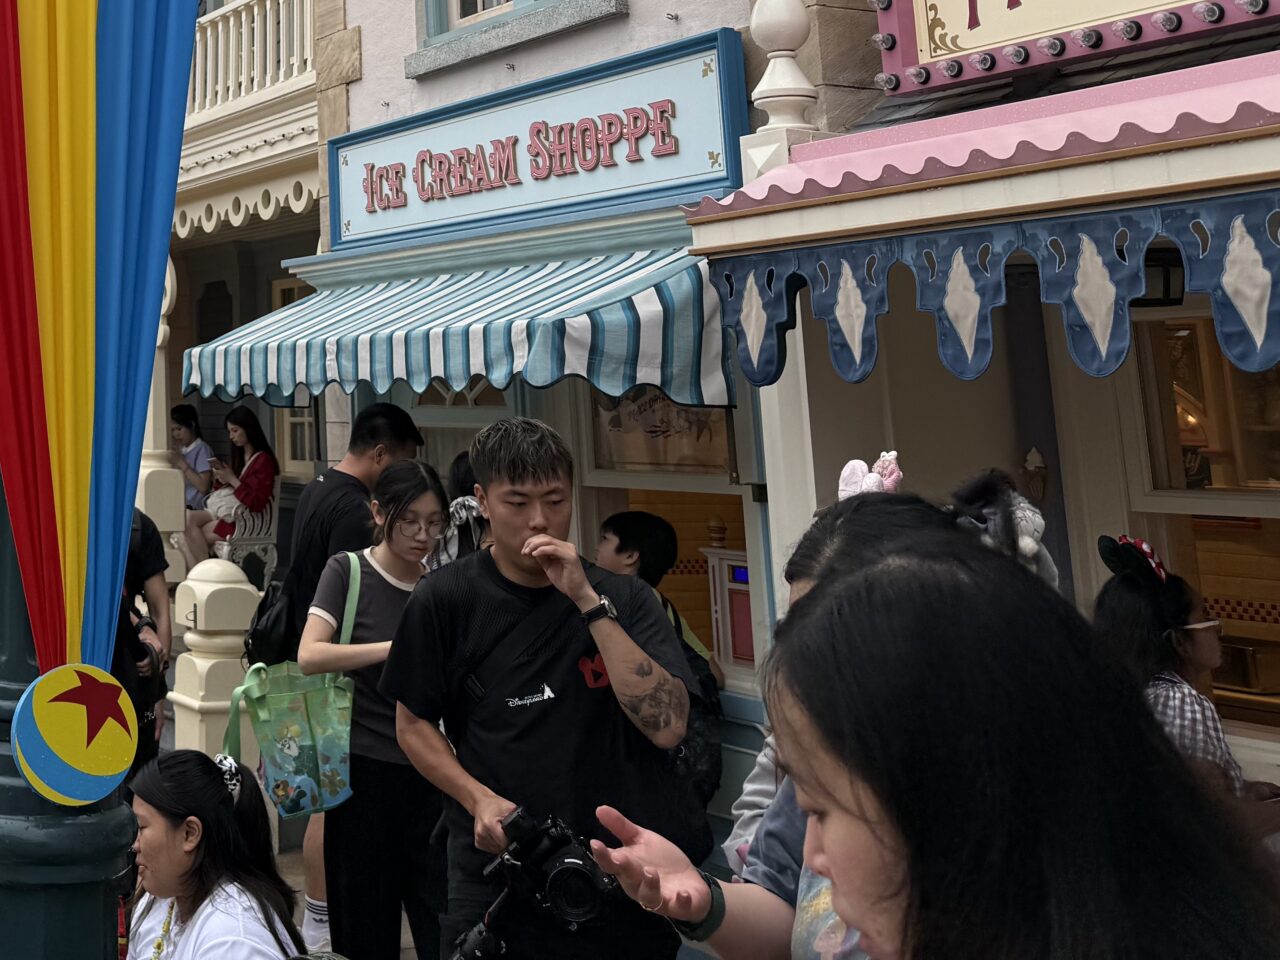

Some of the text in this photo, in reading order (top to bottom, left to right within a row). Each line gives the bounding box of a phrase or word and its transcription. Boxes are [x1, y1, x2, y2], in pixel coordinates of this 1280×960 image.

[363, 98, 681, 214] ICE CREAM SHOPPE
